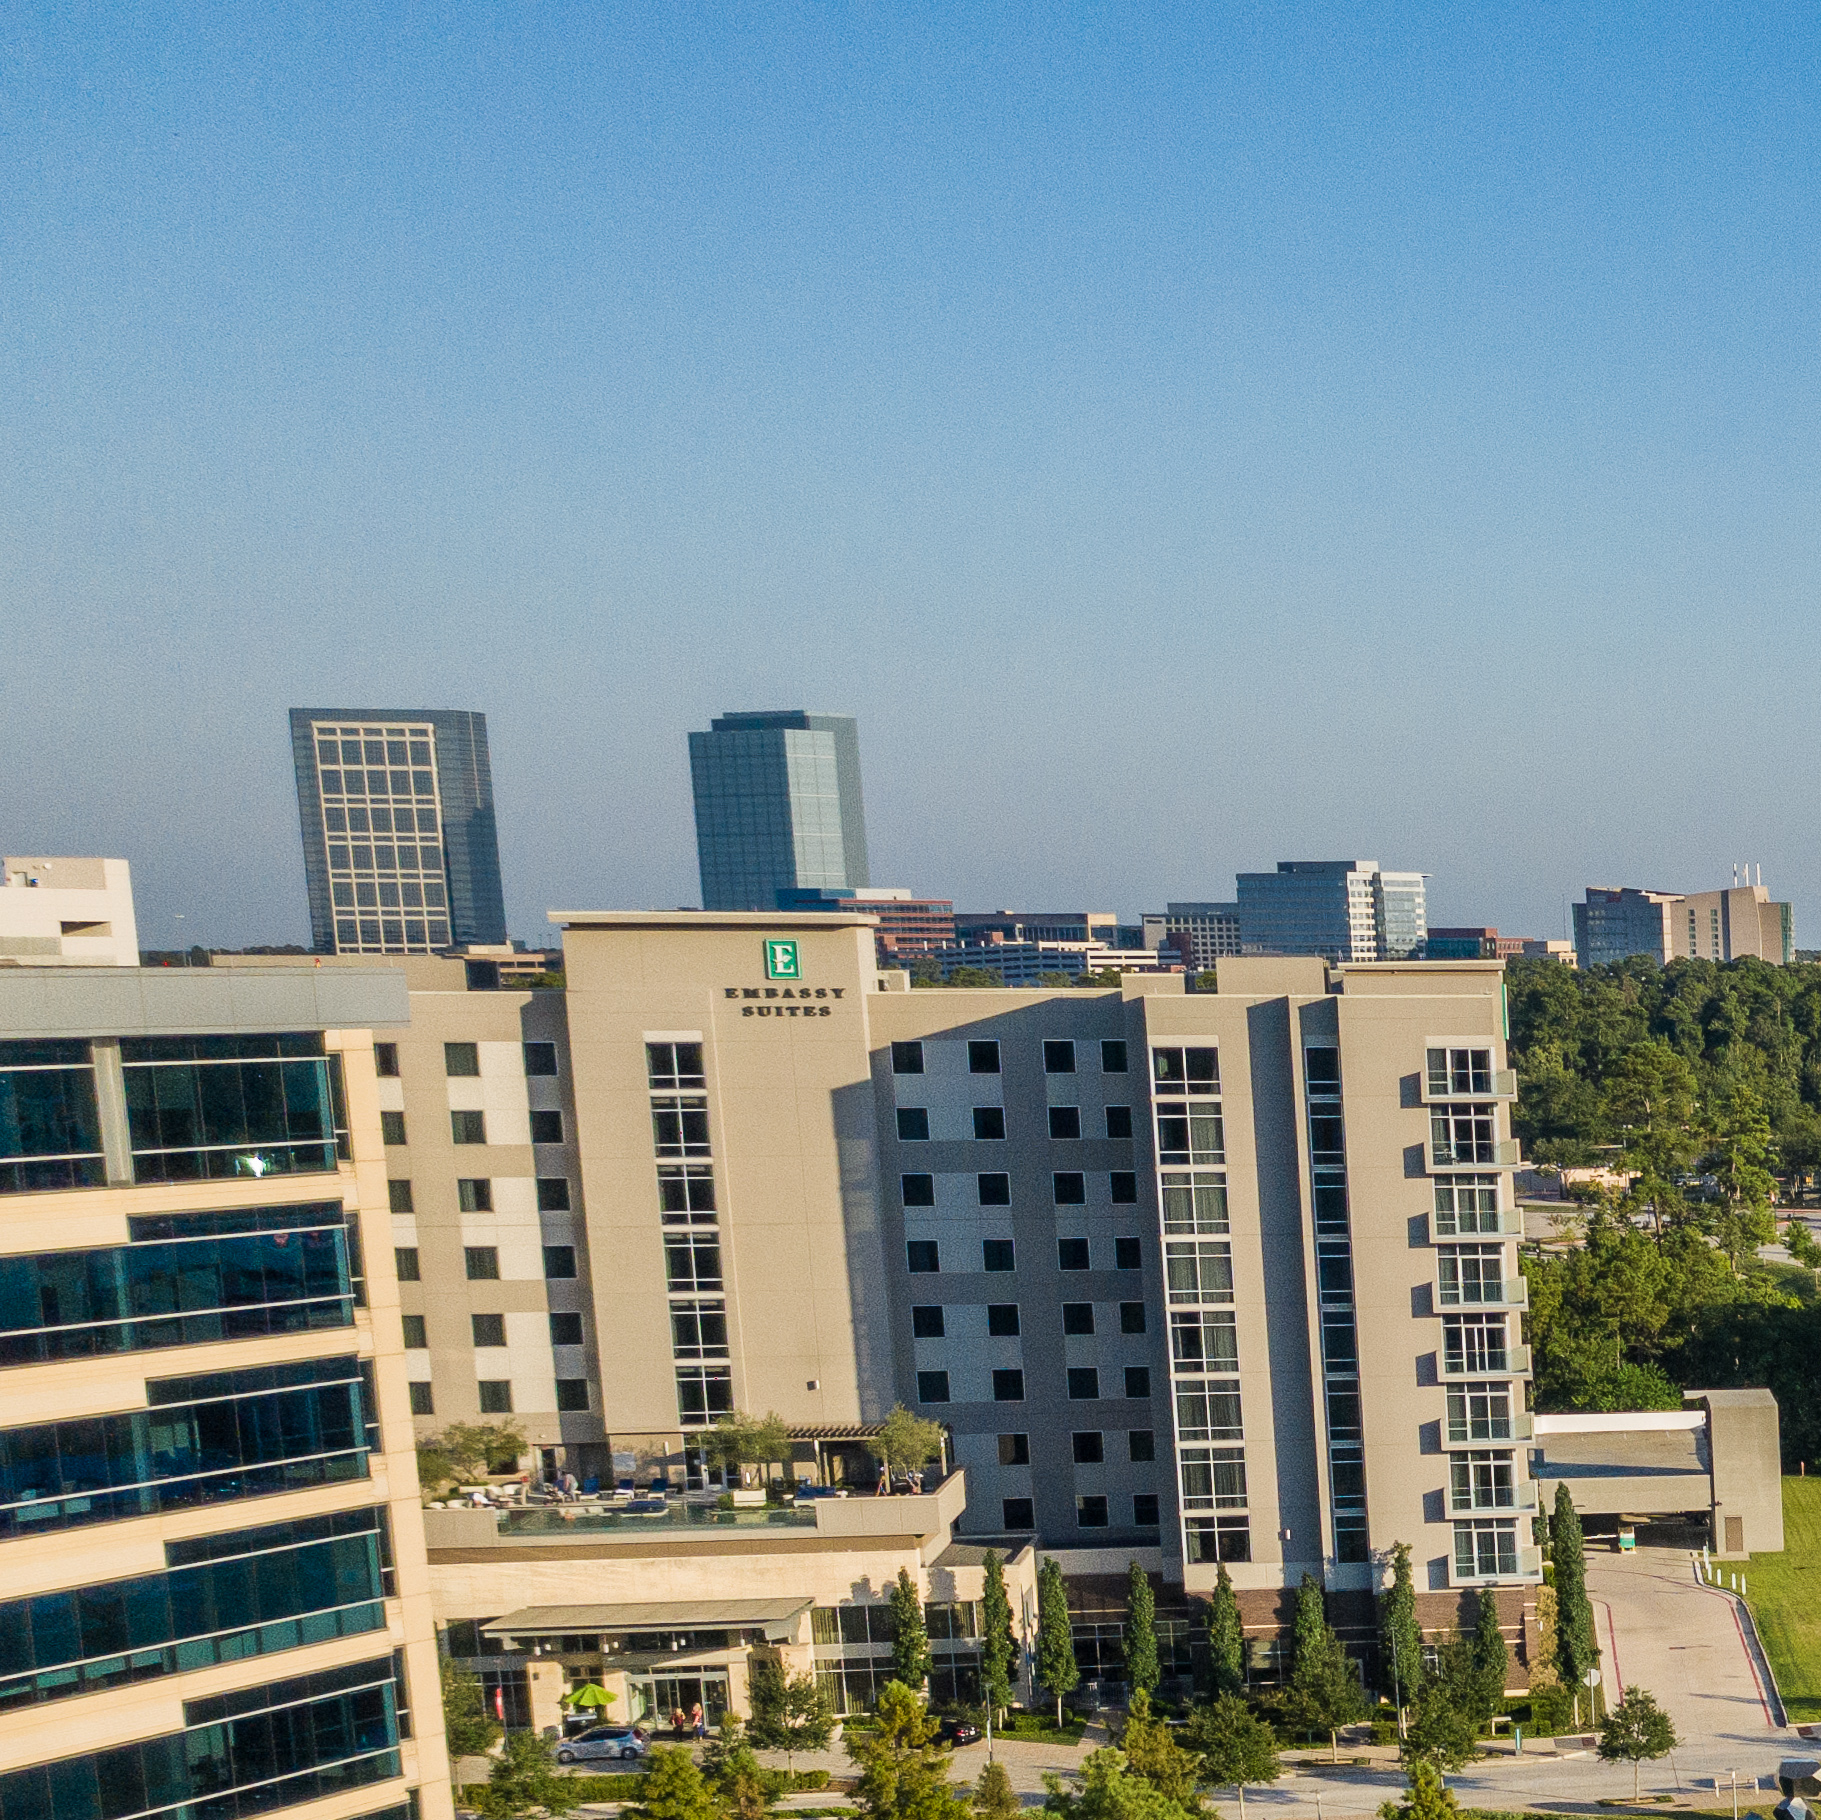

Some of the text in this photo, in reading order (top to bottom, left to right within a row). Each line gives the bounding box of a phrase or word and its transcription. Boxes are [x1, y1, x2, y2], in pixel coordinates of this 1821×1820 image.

[772, 945, 795, 974] E
[724, 987, 846, 999] EMBASSY
[741, 1005, 832, 1018] SUITES
